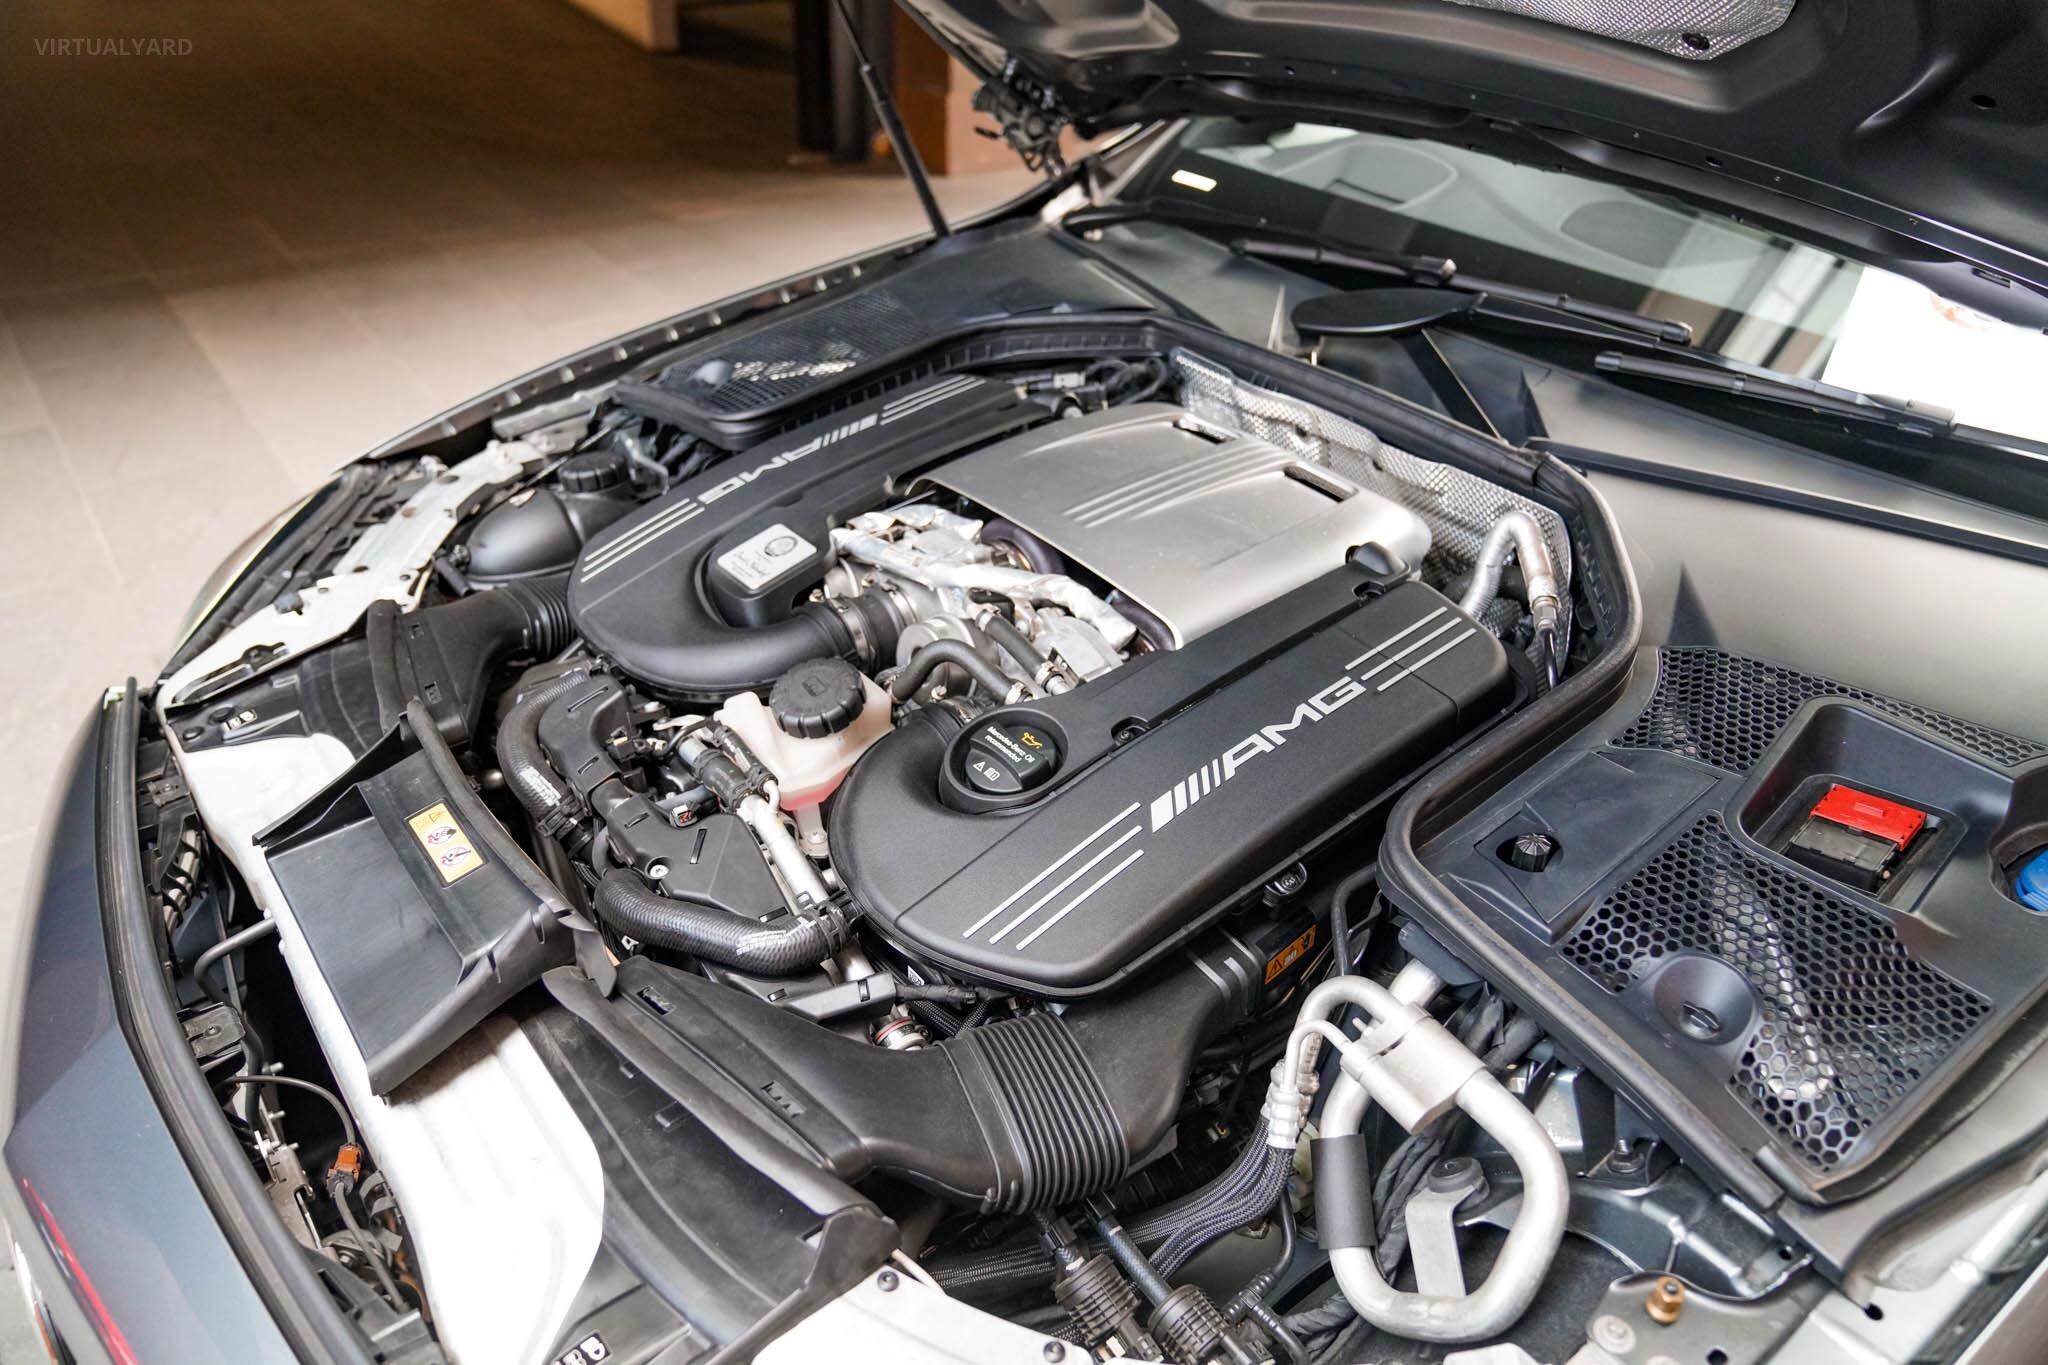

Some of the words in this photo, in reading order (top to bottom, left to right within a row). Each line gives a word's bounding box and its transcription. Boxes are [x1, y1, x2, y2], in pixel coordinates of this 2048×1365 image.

[987, 726, 1026, 757] Mercedes-Benz
[1024, 754, 1035, 763] Oil
[1222, 676, 1367, 781] AMG
[985, 735, 1022, 763] recommended
